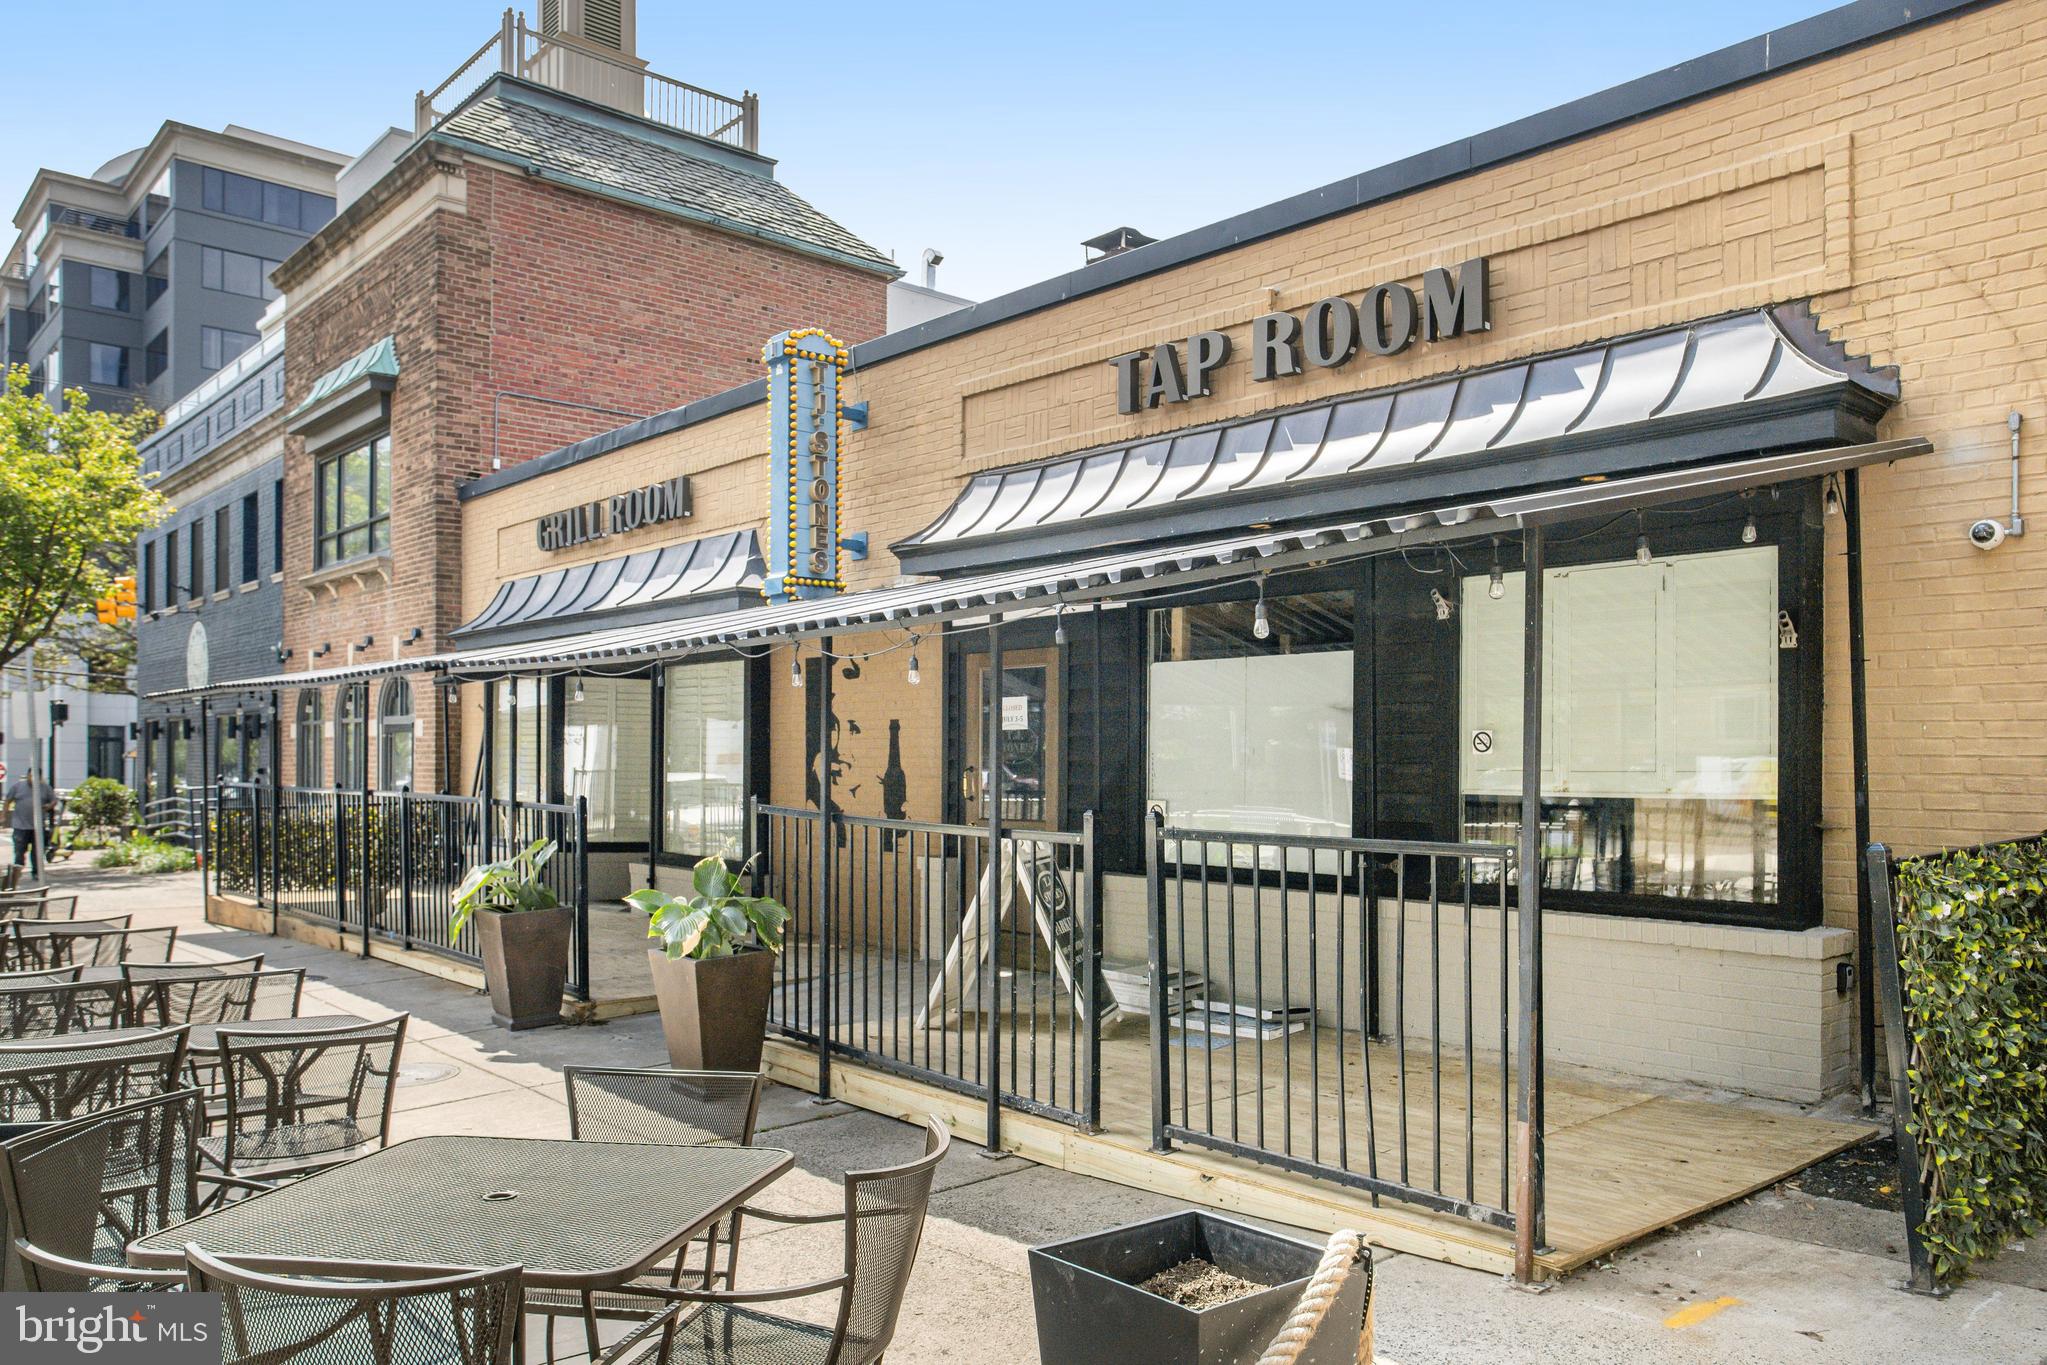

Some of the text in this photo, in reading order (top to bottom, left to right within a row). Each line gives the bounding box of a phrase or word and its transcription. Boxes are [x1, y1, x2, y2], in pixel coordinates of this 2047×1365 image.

[1109, 258, 1490, 416] TAP ROOM
[537, 475, 693, 551] GRILL ROOM
[808, 430, 830, 575] STONES
